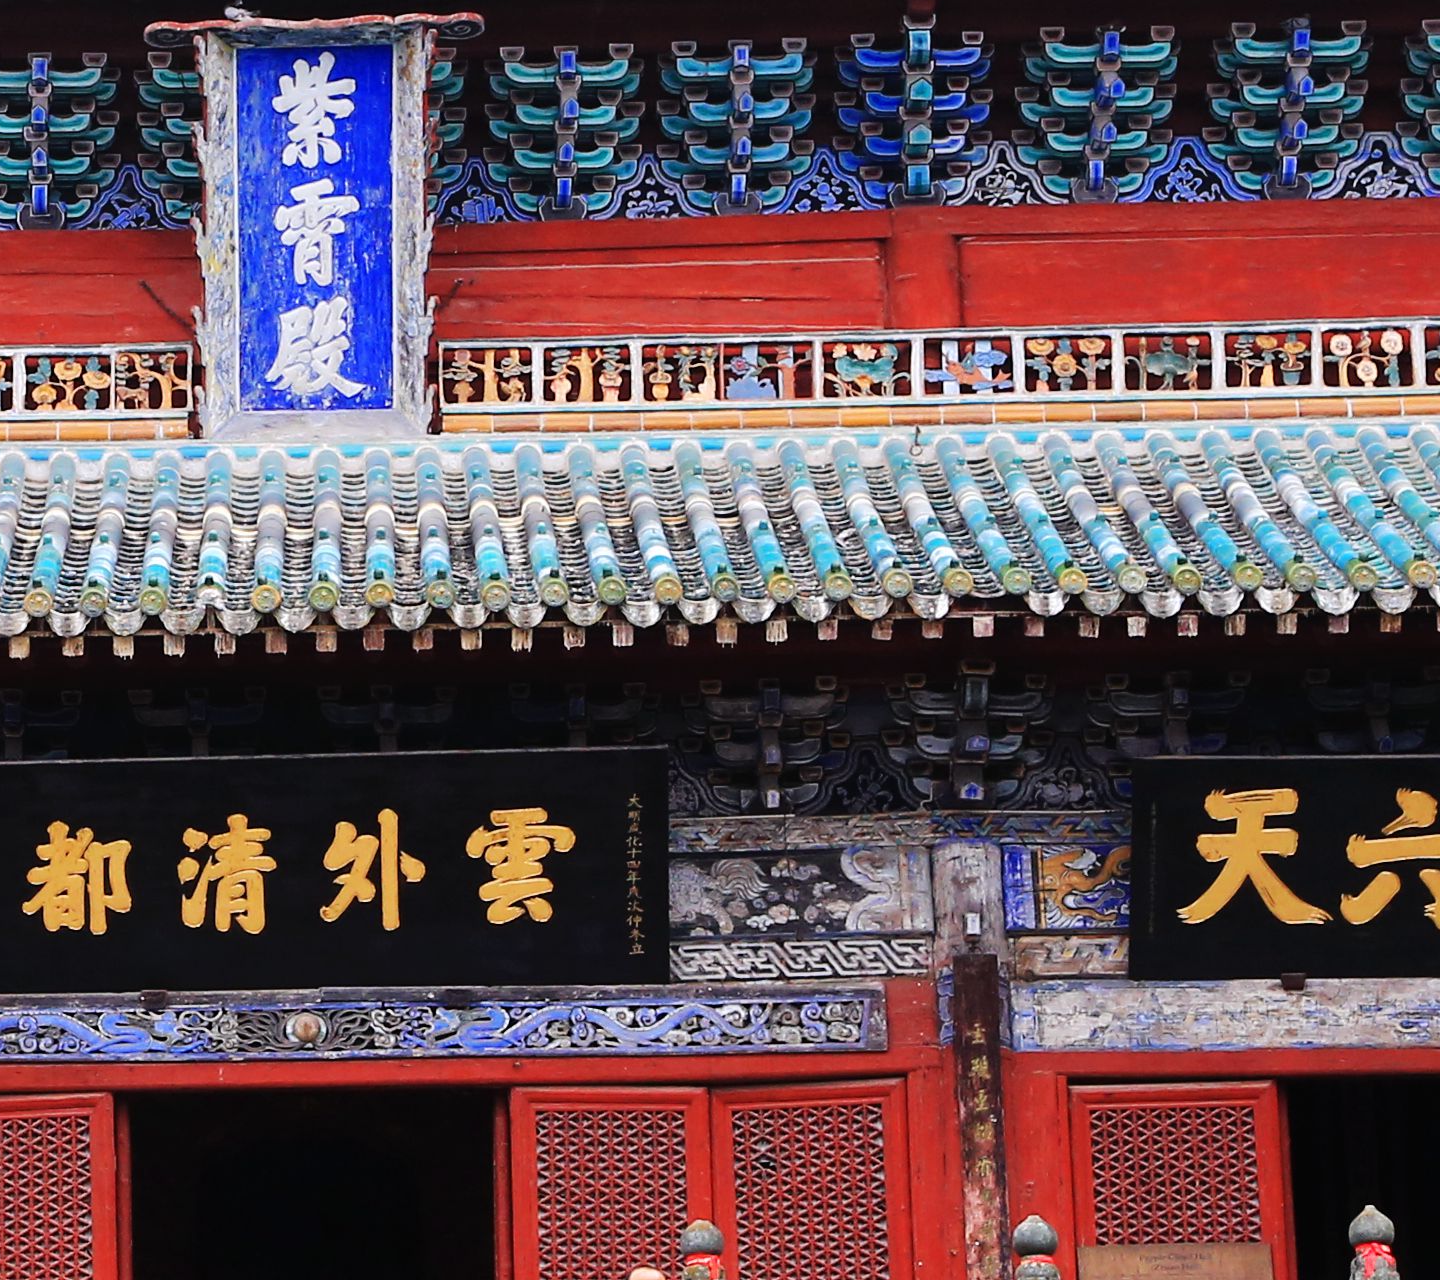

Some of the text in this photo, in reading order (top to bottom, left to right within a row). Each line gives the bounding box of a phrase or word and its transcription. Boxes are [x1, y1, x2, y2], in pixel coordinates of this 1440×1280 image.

[265, 51, 368, 399] 紫霄殿
[21, 807, 576, 935] 雲外清都
